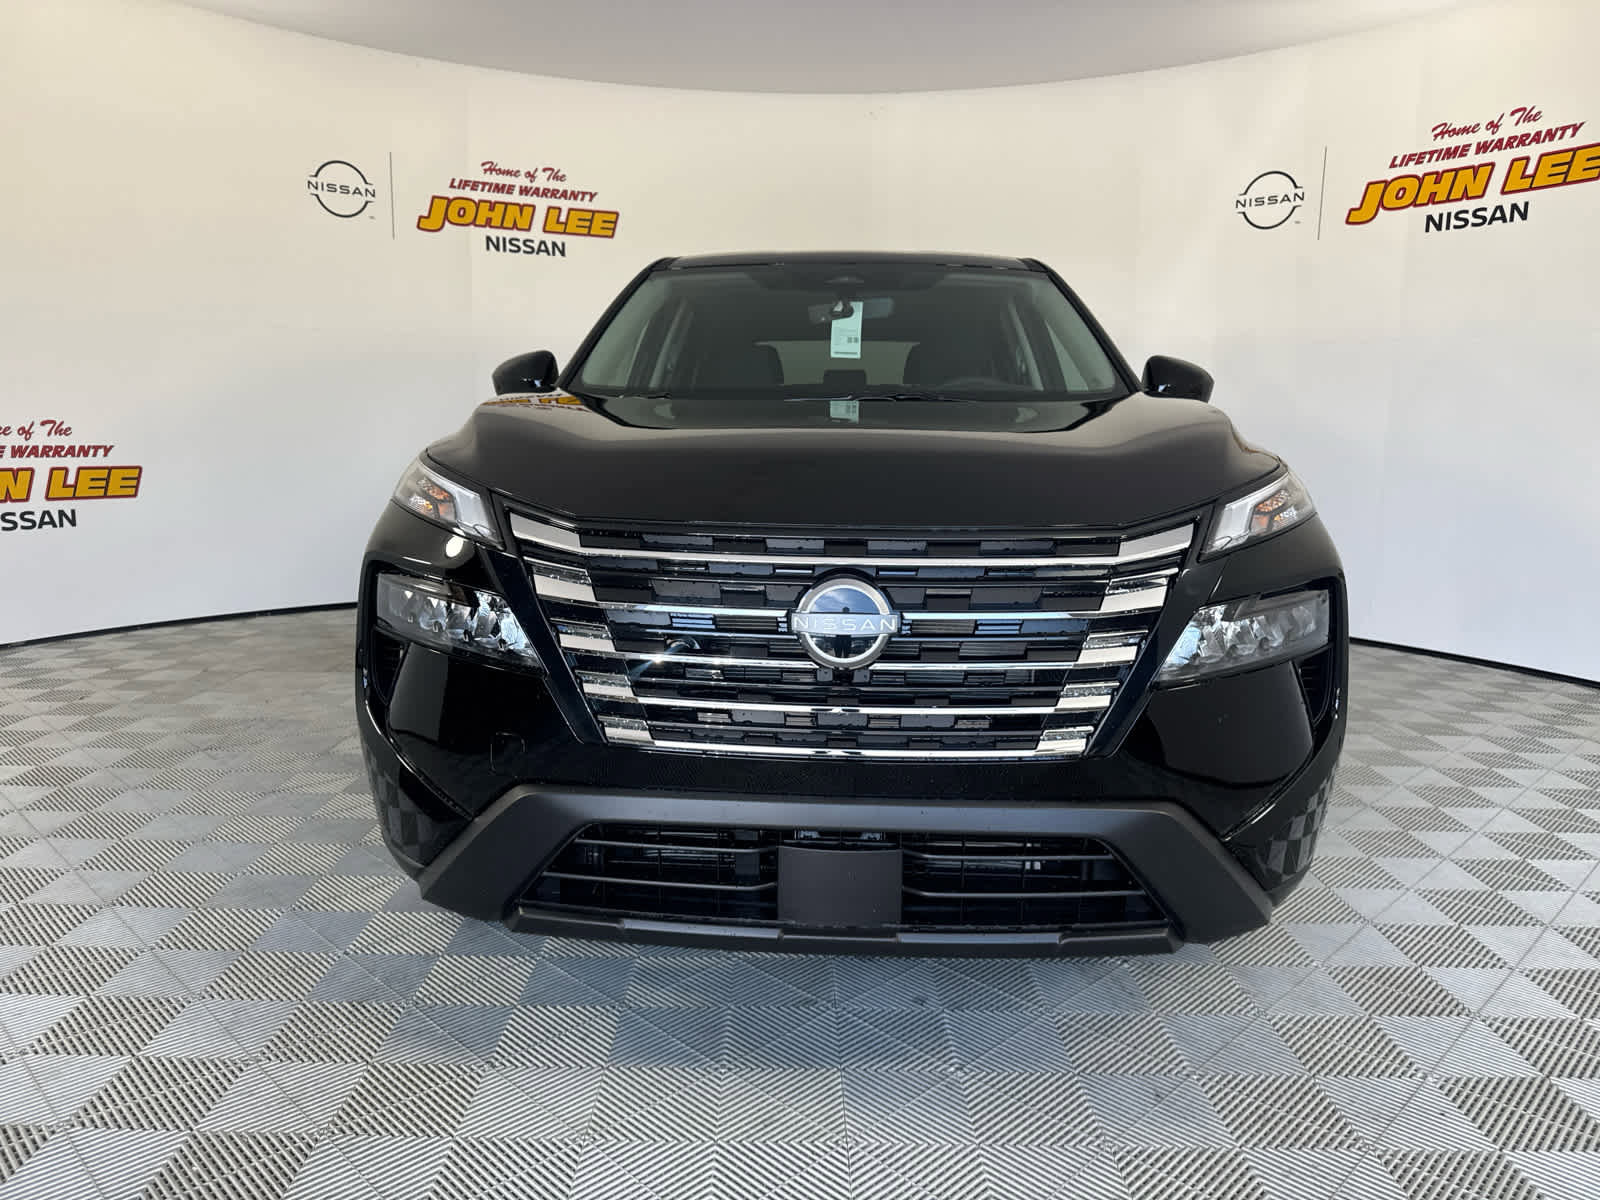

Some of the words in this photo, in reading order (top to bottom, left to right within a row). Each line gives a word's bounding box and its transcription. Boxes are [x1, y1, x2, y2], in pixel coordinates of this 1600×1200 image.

[1431, 120, 1480, 141] Home
[1484, 113, 1505, 133] of
[1509, 106, 1543, 126] The
[1389, 141, 1470, 169] LIFETIME
[1474, 121, 1587, 156] WARRANTY
[480, 160, 521, 179] Home
[523, 166, 539, 182] of
[542, 166, 567, 182] The
[307, 179, 376, 198] NISSAN
[449, 178, 515, 195] LIFETIME
[518, 184, 598, 203] WARRANTY
[1345, 162, 1496, 226] JOHN
[1500, 142, 1600, 196] LEE
[1235, 191, 1305, 210] NISSAN
[416, 195, 536, 232] JOHN
[542, 205, 619, 239] LEE
[1425, 201, 1530, 233] NISSAN
[485, 235, 567, 257] NISSAN
[17, 421, 35, 441] of
[40, 419, 73, 437] The
[10, 445, 114, 459] WARRANTY
[45, 465, 143, 501] LEE
[0, 509, 77, 532] SSAN
[794, 616, 896, 631] NISSAN
